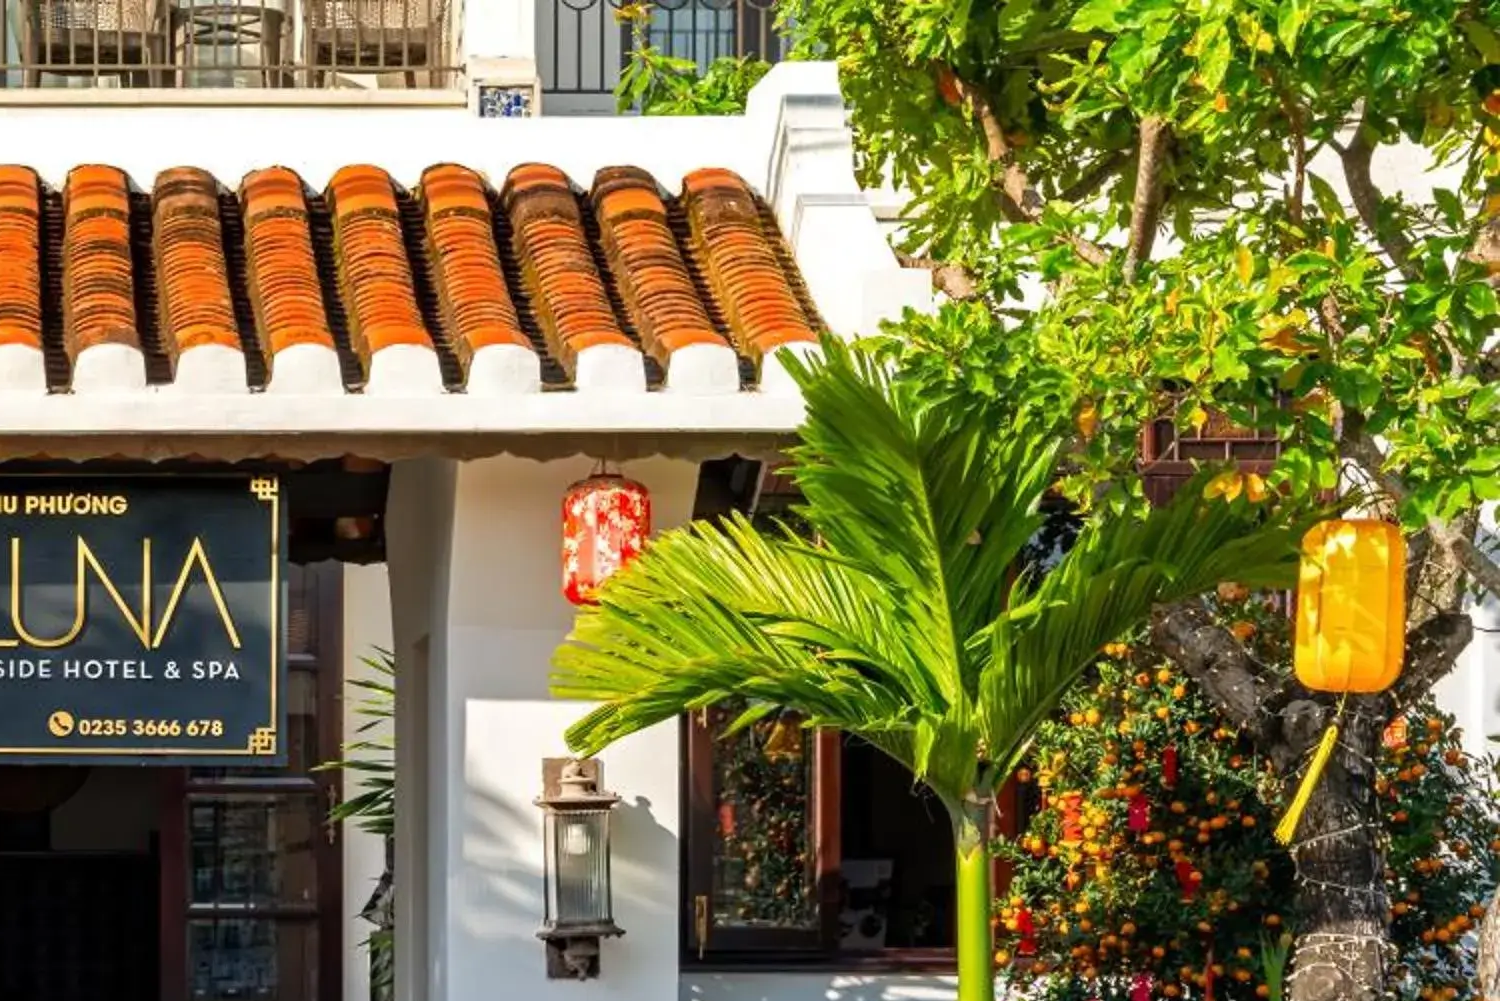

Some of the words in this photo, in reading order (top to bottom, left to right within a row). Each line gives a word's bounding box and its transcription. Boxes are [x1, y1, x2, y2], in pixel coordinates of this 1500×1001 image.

[25, 492, 129, 516] PHƯƠNG
[63, 660, 153, 679] HOTEL
[163, 660, 181, 679] &
[192, 660, 240, 680] SPA
[78, 719, 127, 736] 0235
[132, 719, 181, 737] 3666
[186, 719, 224, 737] 678
